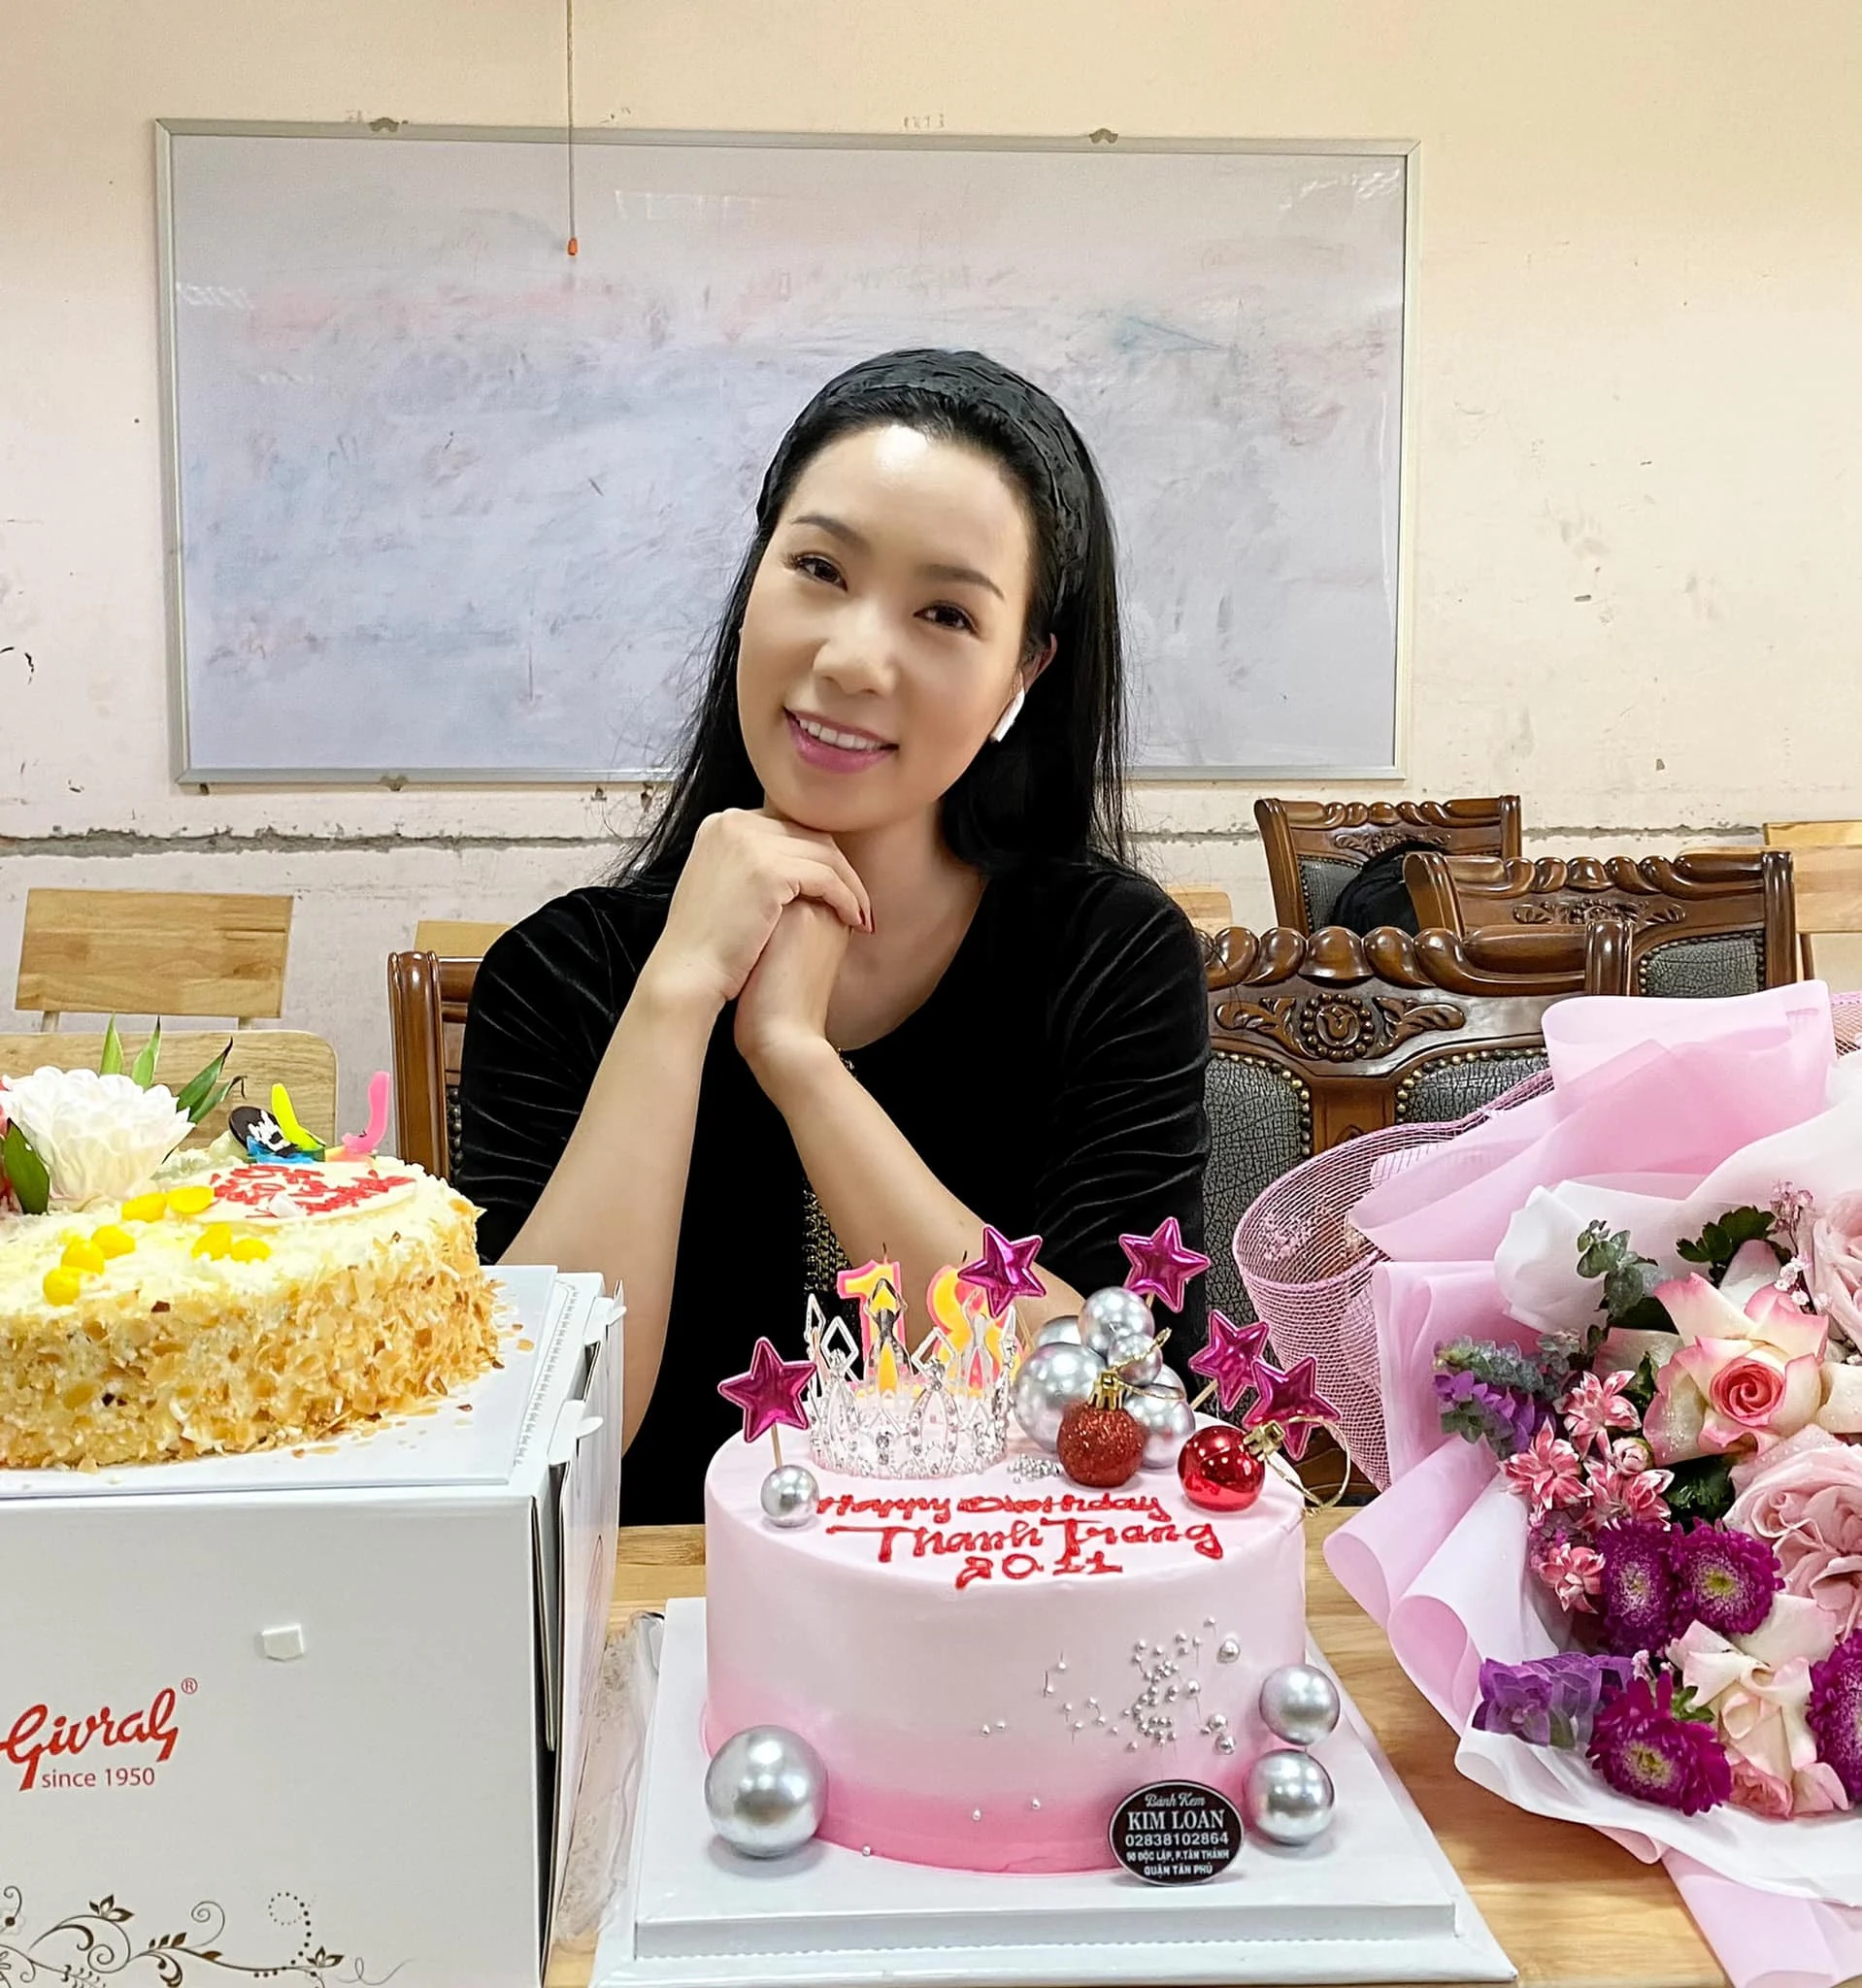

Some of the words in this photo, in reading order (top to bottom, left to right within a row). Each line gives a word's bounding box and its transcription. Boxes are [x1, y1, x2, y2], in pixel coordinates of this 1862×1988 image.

[815, 1494, 951, 1523] Happy
[825, 1519, 1044, 1563] Thanh
[1039, 1517, 1224, 1560] Trang
[0, 1687, 180, 1792] Givral
[41, 1768, 97, 1789] since
[104, 1767, 155, 1787] 1950
[1178, 1792, 1206, 1807] Kem
[1127, 1810, 1166, 1831] KIM
[1171, 1808, 1225, 1830] LOAN
[1124, 1832, 1230, 1847] 02838102864
